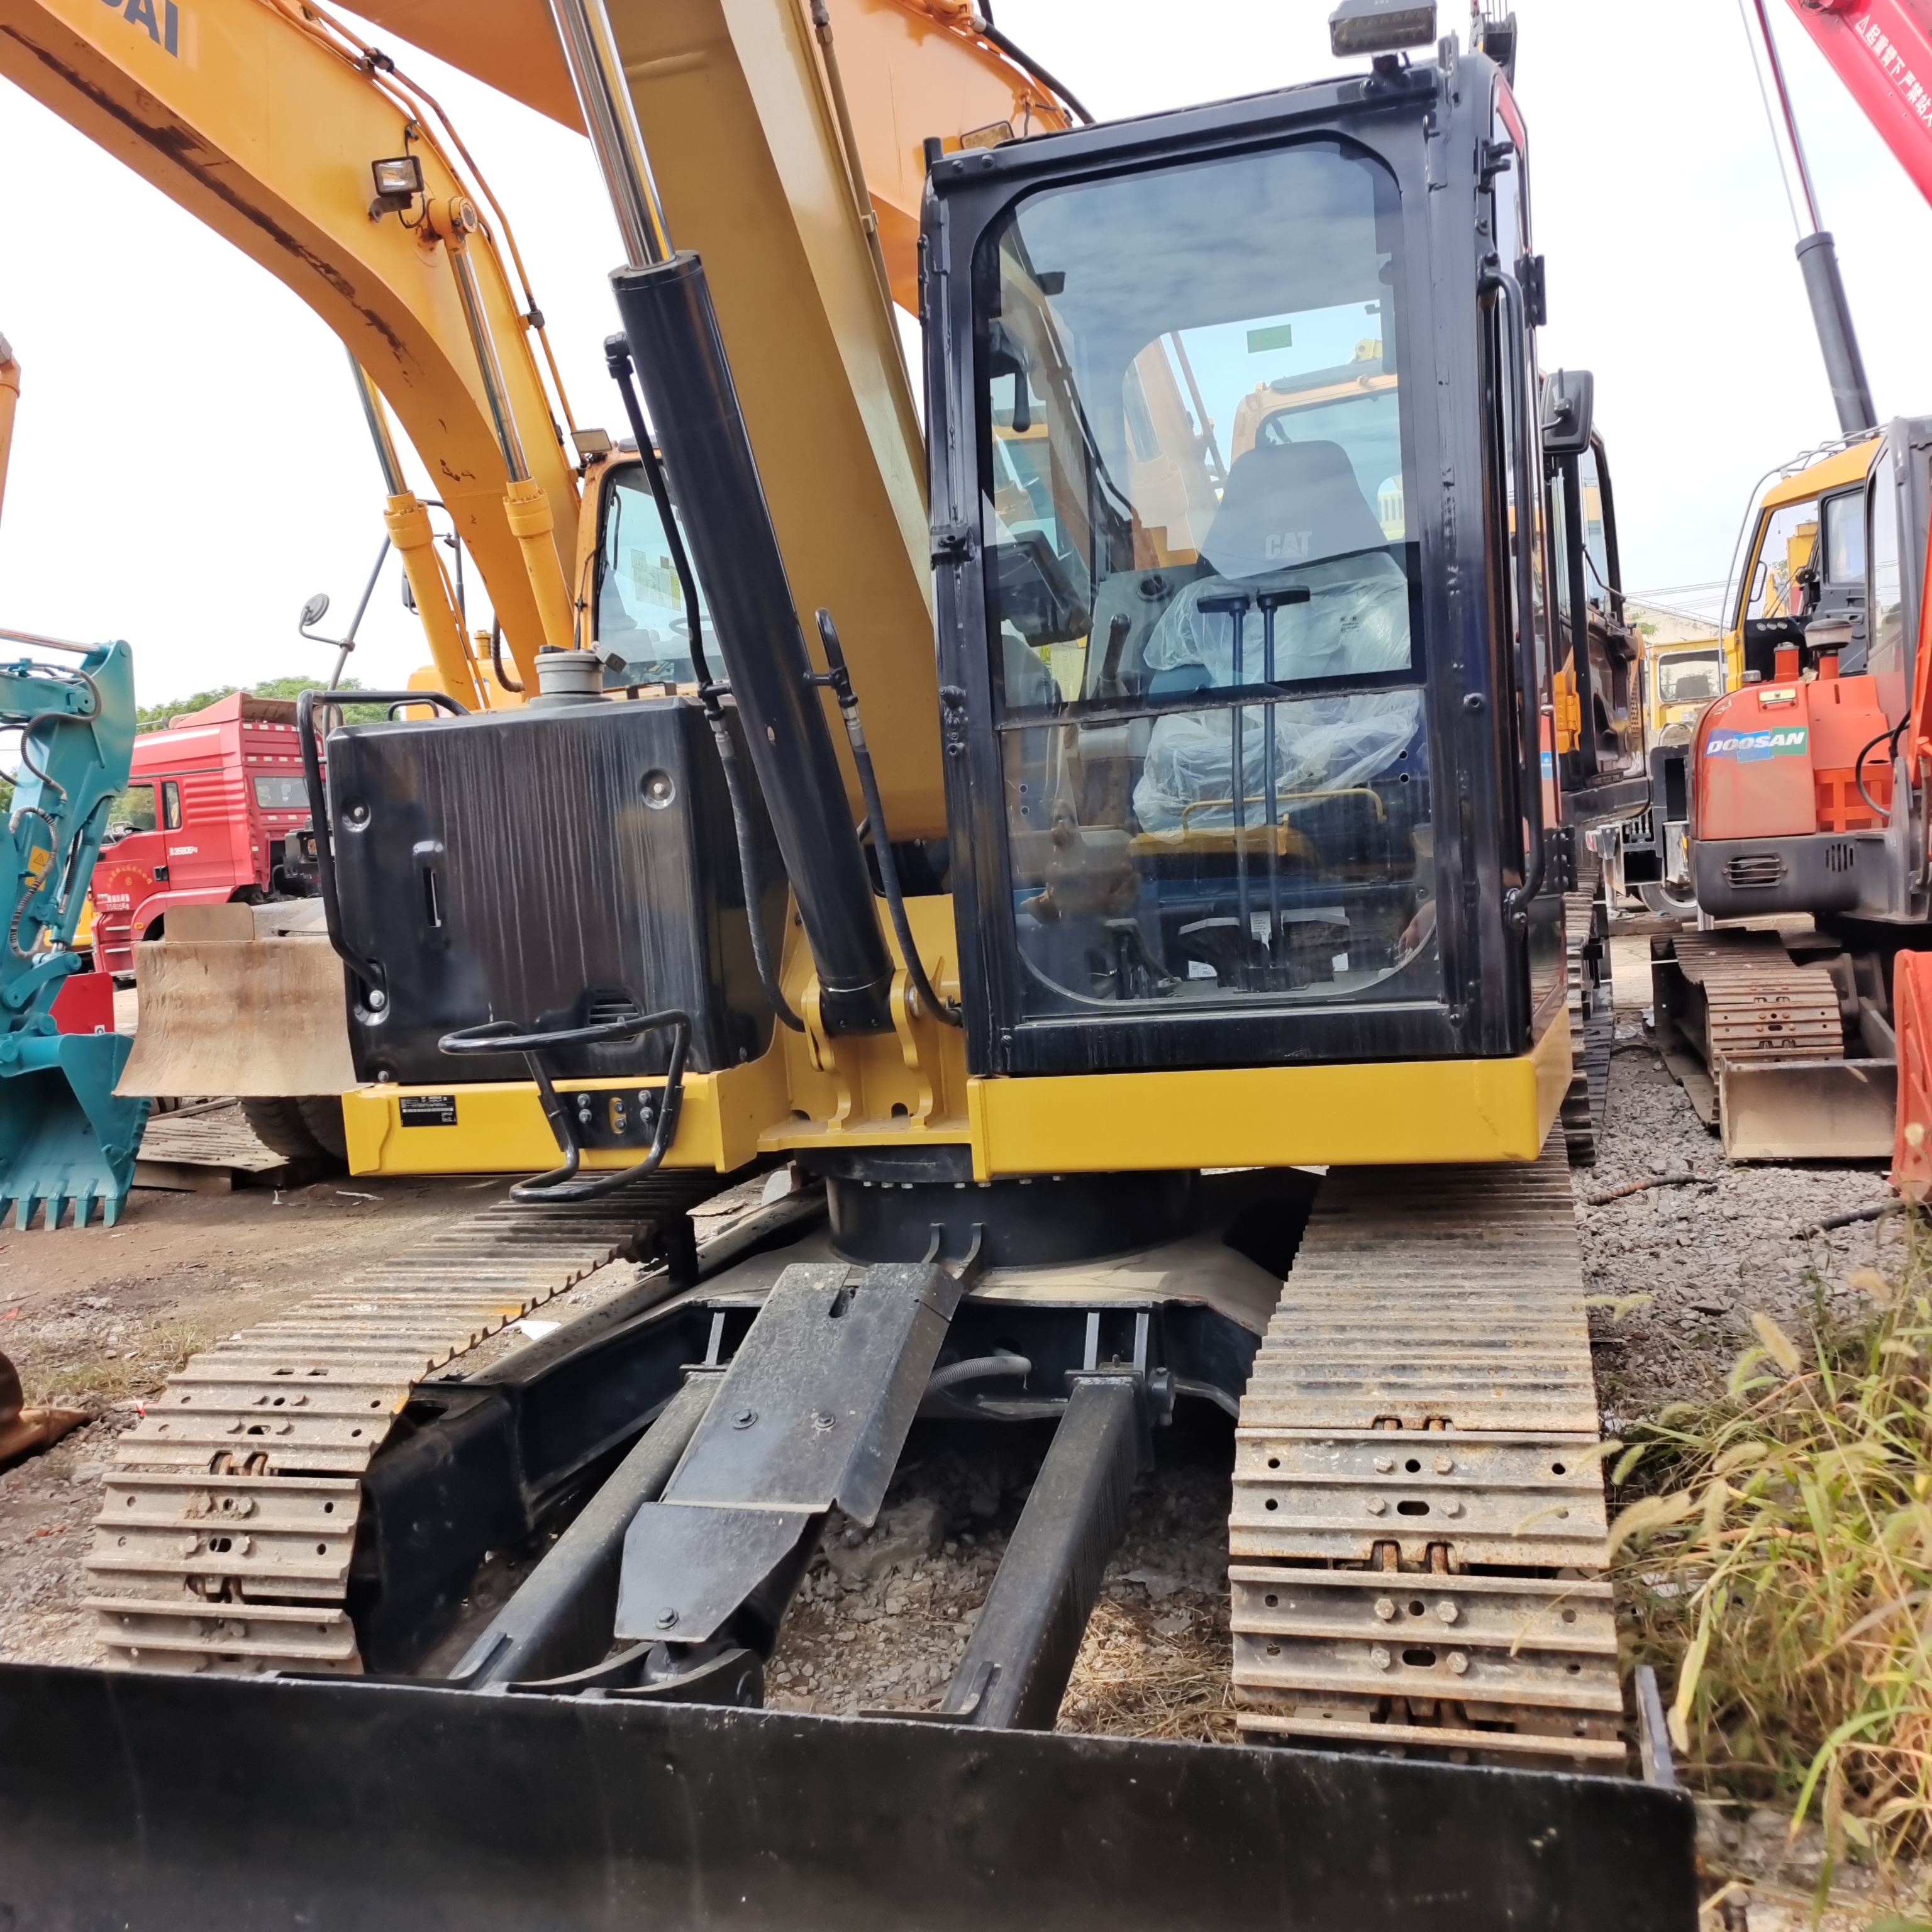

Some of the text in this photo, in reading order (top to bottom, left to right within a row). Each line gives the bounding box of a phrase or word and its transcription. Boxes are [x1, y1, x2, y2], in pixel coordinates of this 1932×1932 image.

[102, 0, 178, 58] AI
[1865, 23, 1906, 75] 起重臂下
[1265, 531, 1312, 560] CAT
[1707, 731, 1805, 755] DOOSAN
